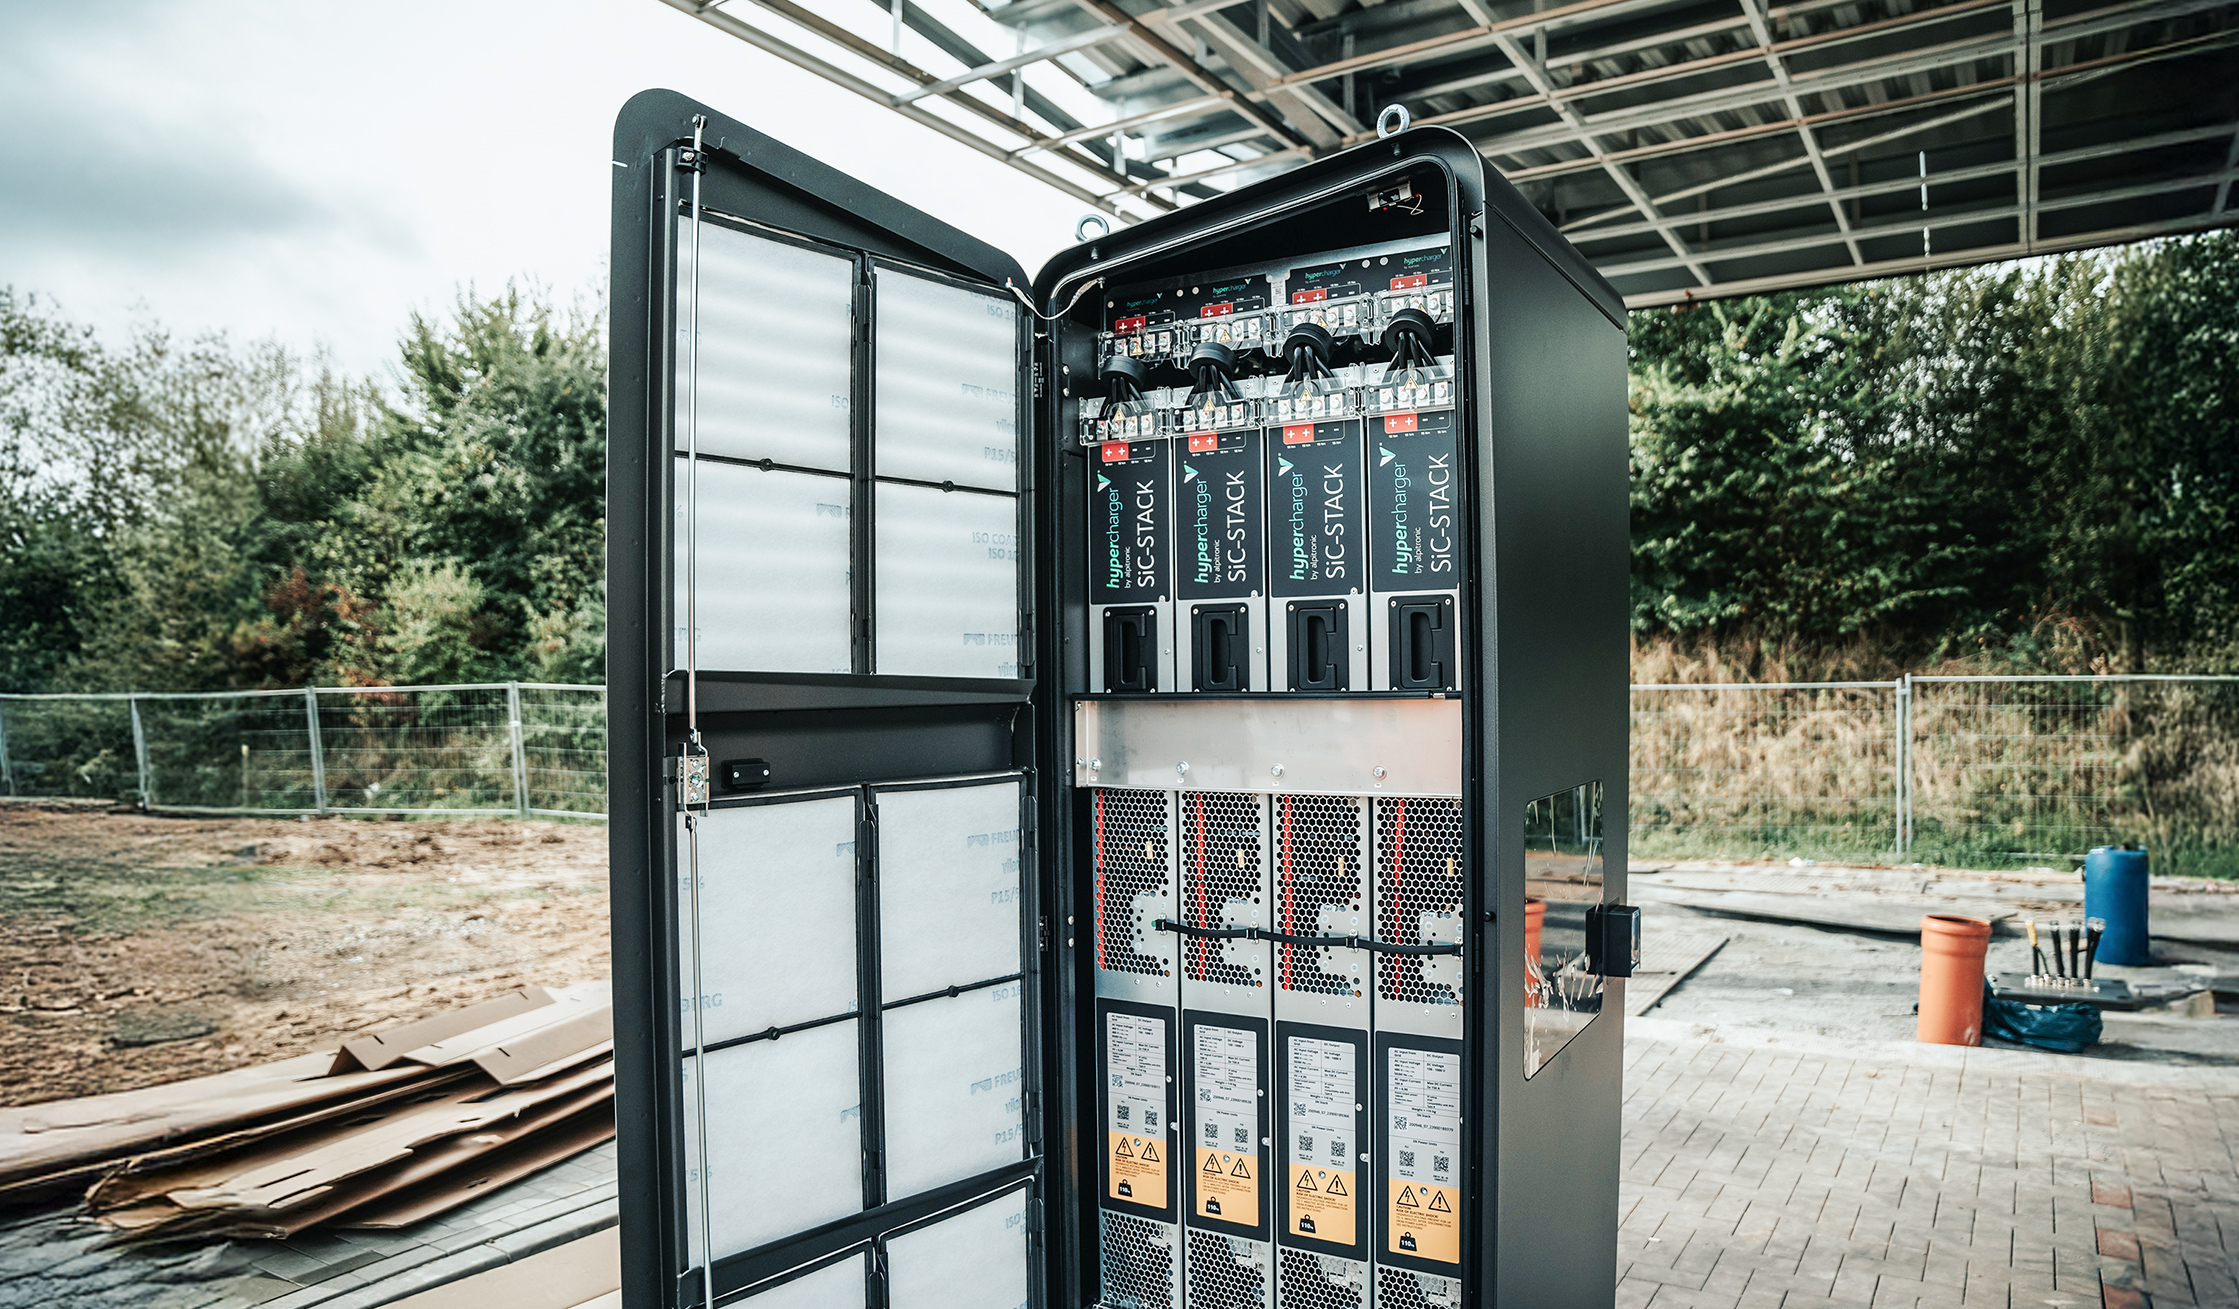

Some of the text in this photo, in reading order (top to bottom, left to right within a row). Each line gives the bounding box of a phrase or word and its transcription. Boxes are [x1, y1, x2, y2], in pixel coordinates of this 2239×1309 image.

[1304, 268, 1342, 281] hypercharger
[1403, 253, 1442, 266] hypercharger
[987, 304, 1003, 318] ISO
[1212, 283, 1247, 295] hypercharger
[831, 394, 849, 410] ISO
[1136, 479, 1155, 588] SiC-STACK
[1194, 478, 1212, 584] hypercharger
[1226, 470, 1247, 582] SiC-STACK
[1288, 471, 1309, 581] hypercharger
[1323, 463, 1346, 579] SiC-STACK
[1390, 462, 1413, 574] hypercharger
[1428, 452, 1452, 572] SiC-STACK
[972, 531, 989, 544] ISO
[988, 547, 1005, 560] ISO
[1106, 487, 1124, 589] hypercharger
[1310, 534, 1319, 580] by alpitronic
[1414, 526, 1424, 574] by alpitronic
[1214, 539, 1222, 583] by alpitronic
[1124, 578, 1132, 589] by
[992, 987, 1009, 1002] ISO
[1006, 1213, 1020, 1229] ISO
